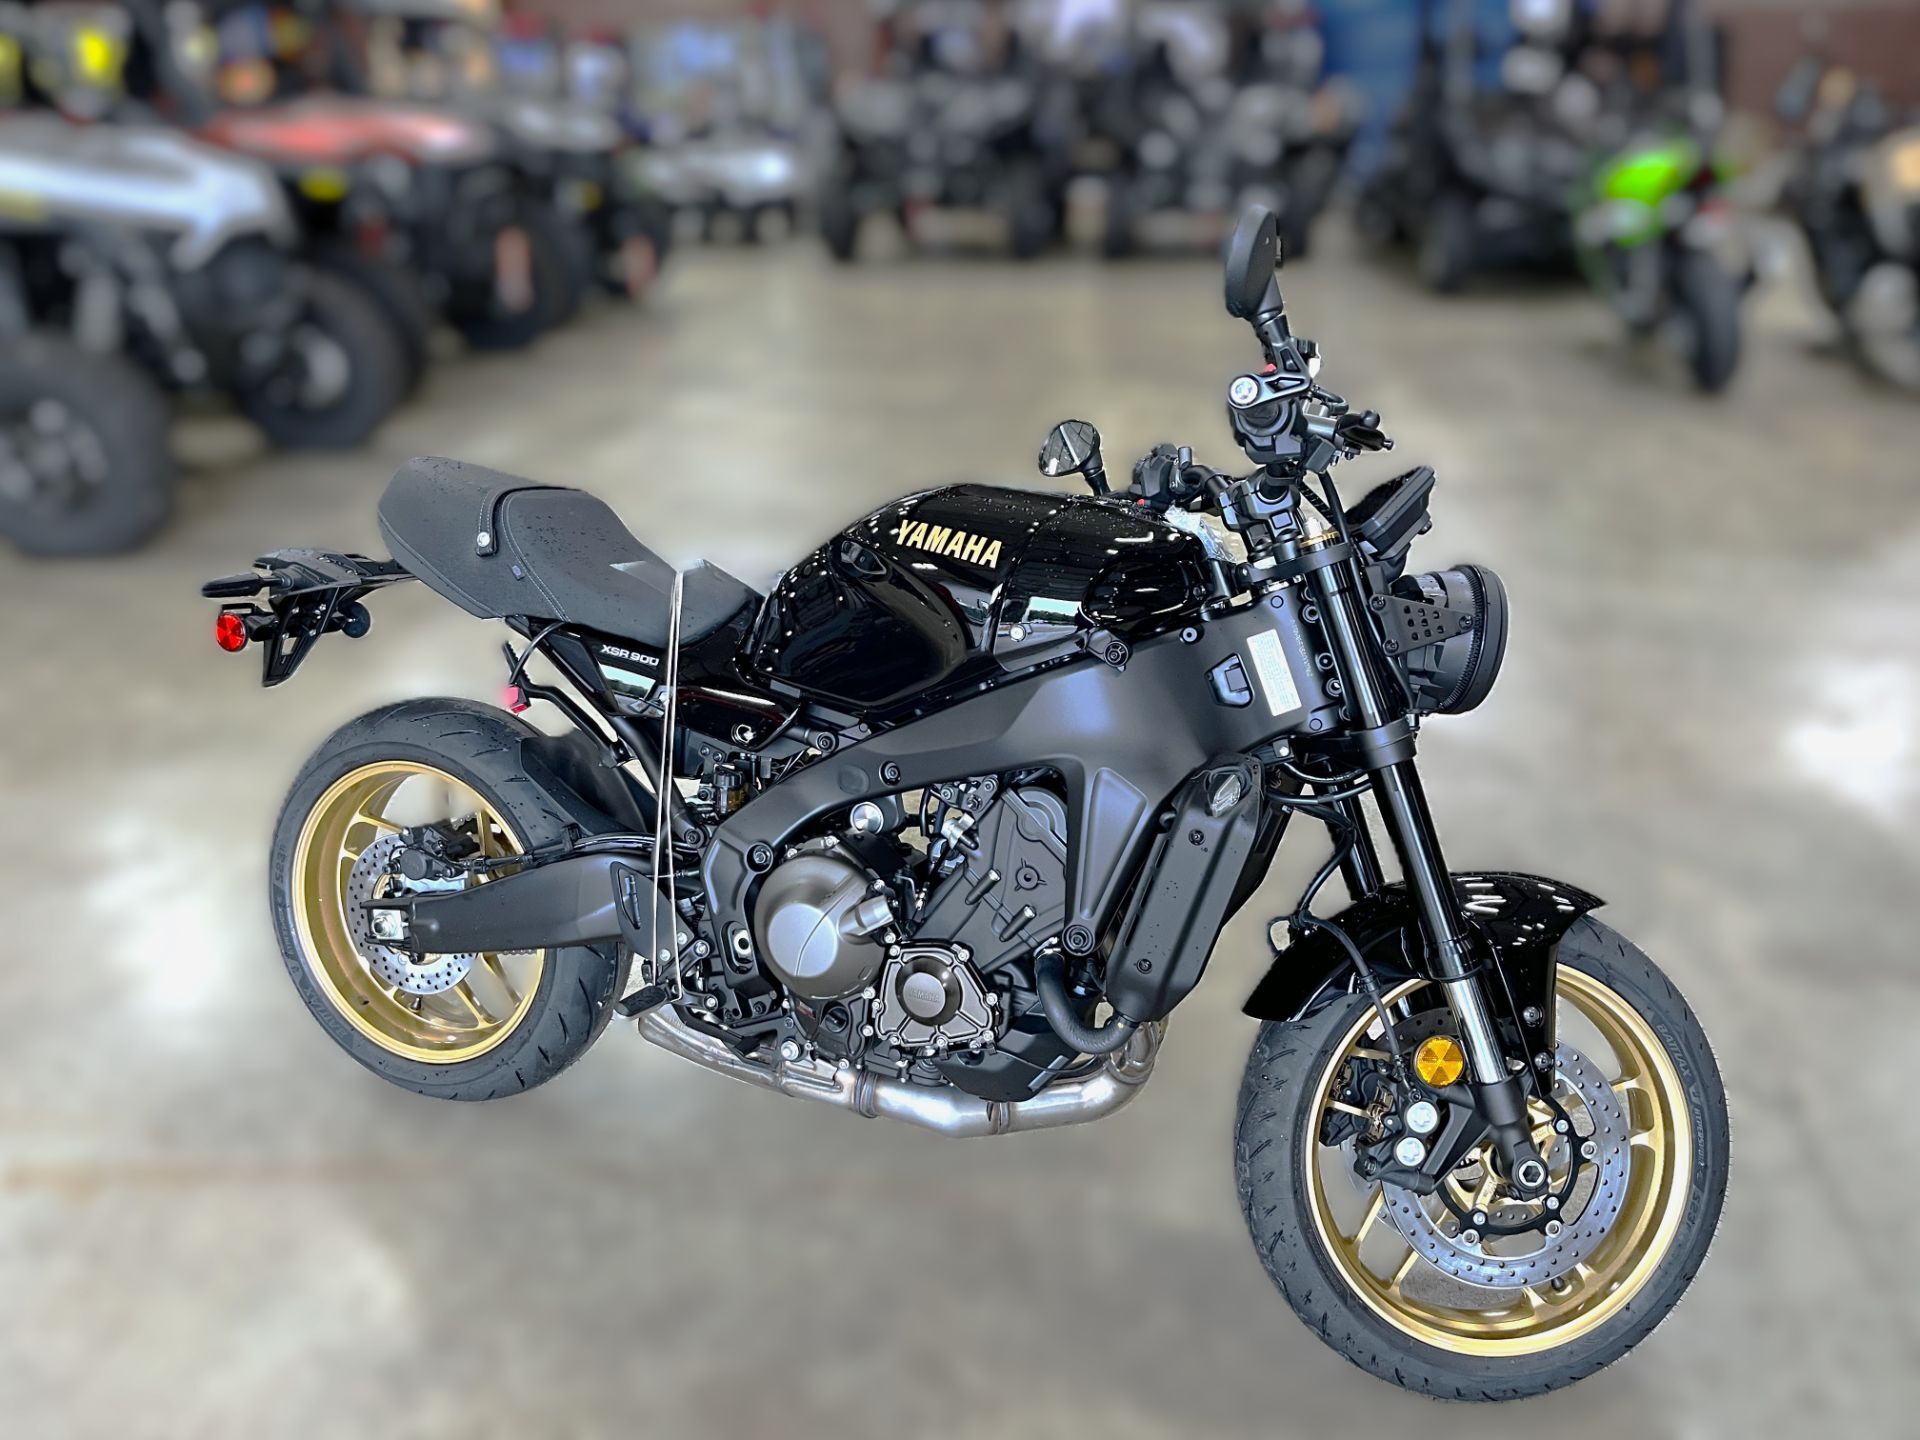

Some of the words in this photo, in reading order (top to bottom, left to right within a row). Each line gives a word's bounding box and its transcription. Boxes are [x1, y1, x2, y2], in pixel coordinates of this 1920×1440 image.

[896, 519, 1002, 569] YAMAHA
[601, 644, 630, 658] XSR
[631, 652, 660, 667] 900
